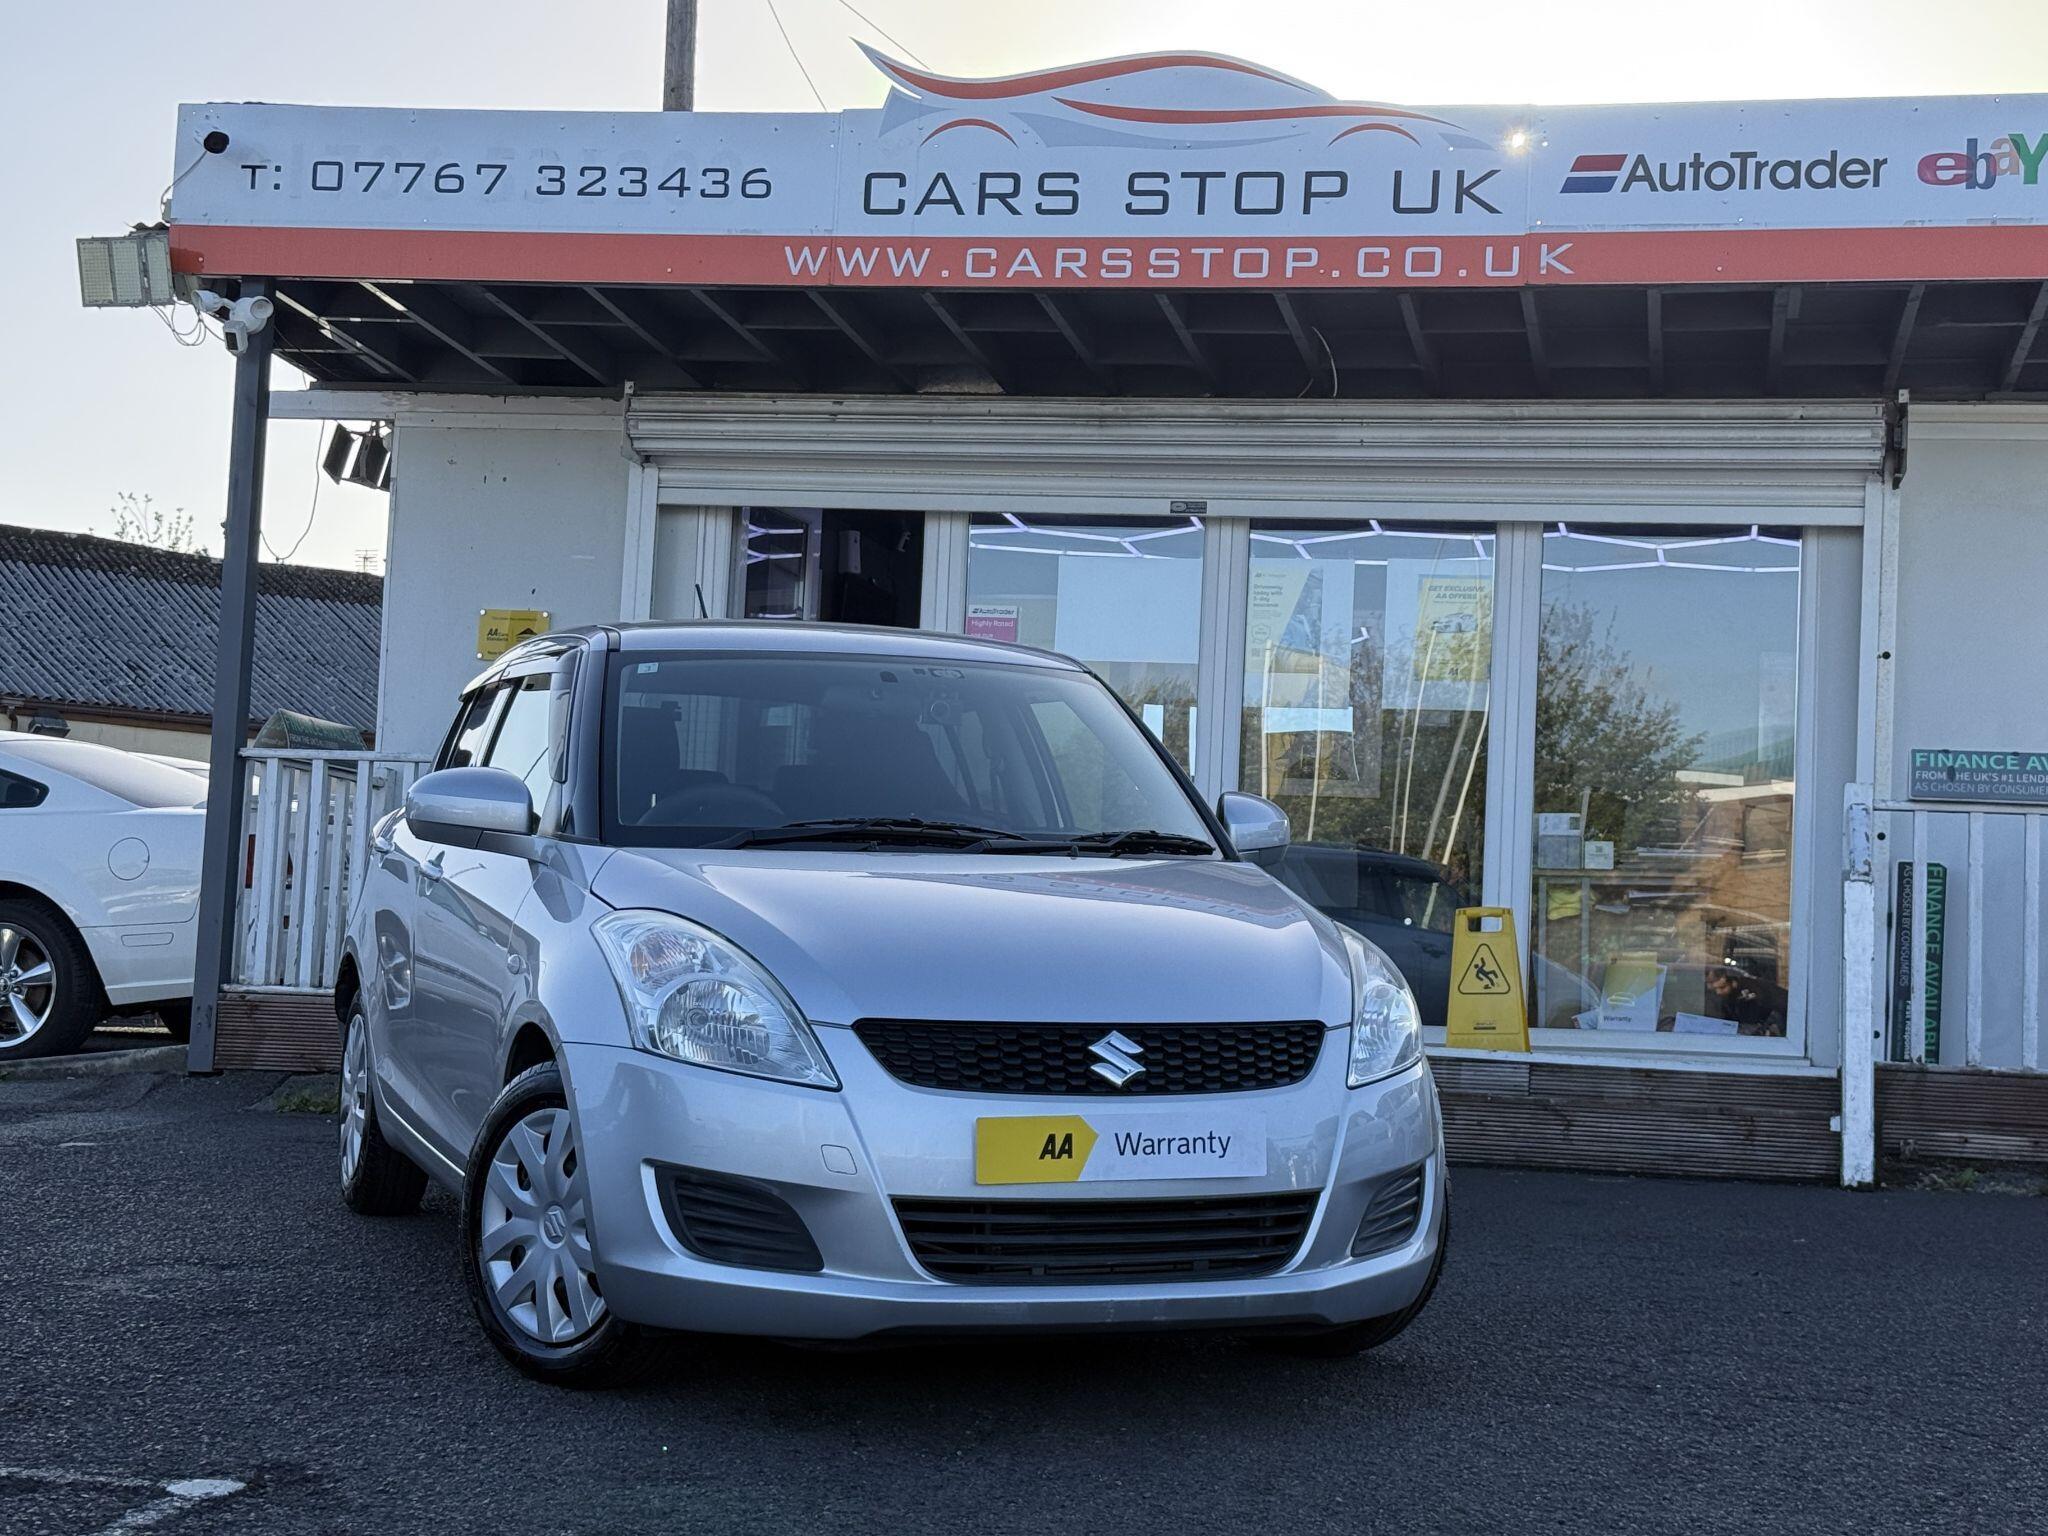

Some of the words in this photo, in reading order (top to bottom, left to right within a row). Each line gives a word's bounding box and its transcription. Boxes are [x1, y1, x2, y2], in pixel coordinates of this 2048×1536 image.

[241, 164, 282, 191] T:
[311, 161, 507, 193] 07767
[536, 164, 773, 199] 323436
[1621, 150, 1888, 193] AutoTrader
[863, 172, 1080, 216] CARS
[1125, 171, 1349, 215] STOP
[1392, 169, 1503, 214] UK
[784, 242, 1576, 278] WWW.CARSSTOP.CO.UK
[1915, 752, 2020, 770] FINANCE
[1915, 770, 1947, 780] FROM
[1973, 773, 1999, 782] UK'S
[1915, 781, 1929, 791] AS
[1930, 782, 1975, 793] CHOSEN
[1977, 784, 1991, 793] BY
[1926, 866, 1944, 955] FINANCE
[1900, 929, 1911, 987] CONSUMERS
[1039, 1133, 1073, 1160] AA
[1115, 1130, 1231, 1158] Warranty
